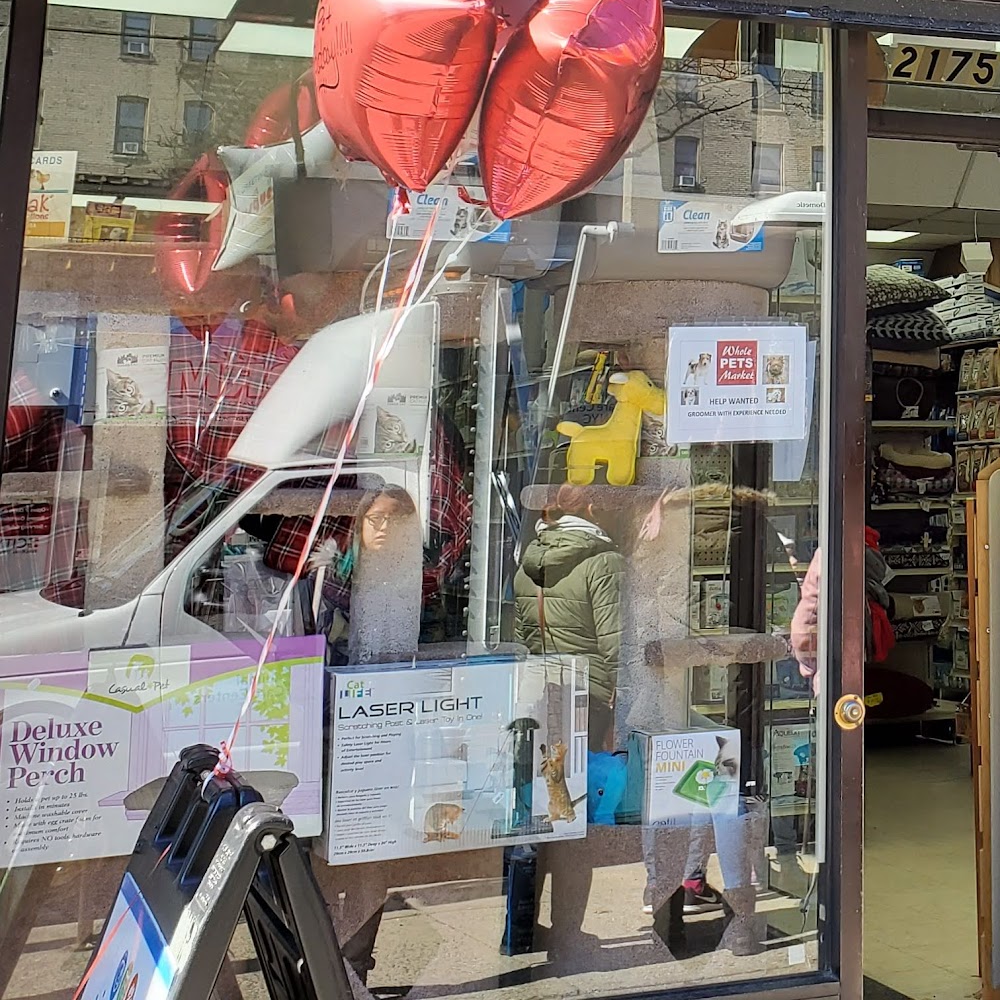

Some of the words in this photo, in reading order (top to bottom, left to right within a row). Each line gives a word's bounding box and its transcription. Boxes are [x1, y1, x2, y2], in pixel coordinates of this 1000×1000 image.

[892, 46, 998, 85] 2175
[683, 210, 710, 220] Clean
[722, 345, 752, 356] Whole
[720, 358, 753, 369] PETS
[718, 370, 755, 382] Market
[729, 397, 759, 405] WANTED
[347, 681, 365, 689] Cat
[338, 702, 415, 720] LASER
[421, 696, 483, 713] LIGHT
[10, 717, 103, 743] Deluxe
[338, 719, 382, 731] Scratching
[656, 738, 694, 751] FLOWER
[9, 738, 119, 766] Window
[655, 749, 704, 761] FOUNTAIN
[656, 761, 685, 773] MINI
[6, 762, 86, 790] Perch
